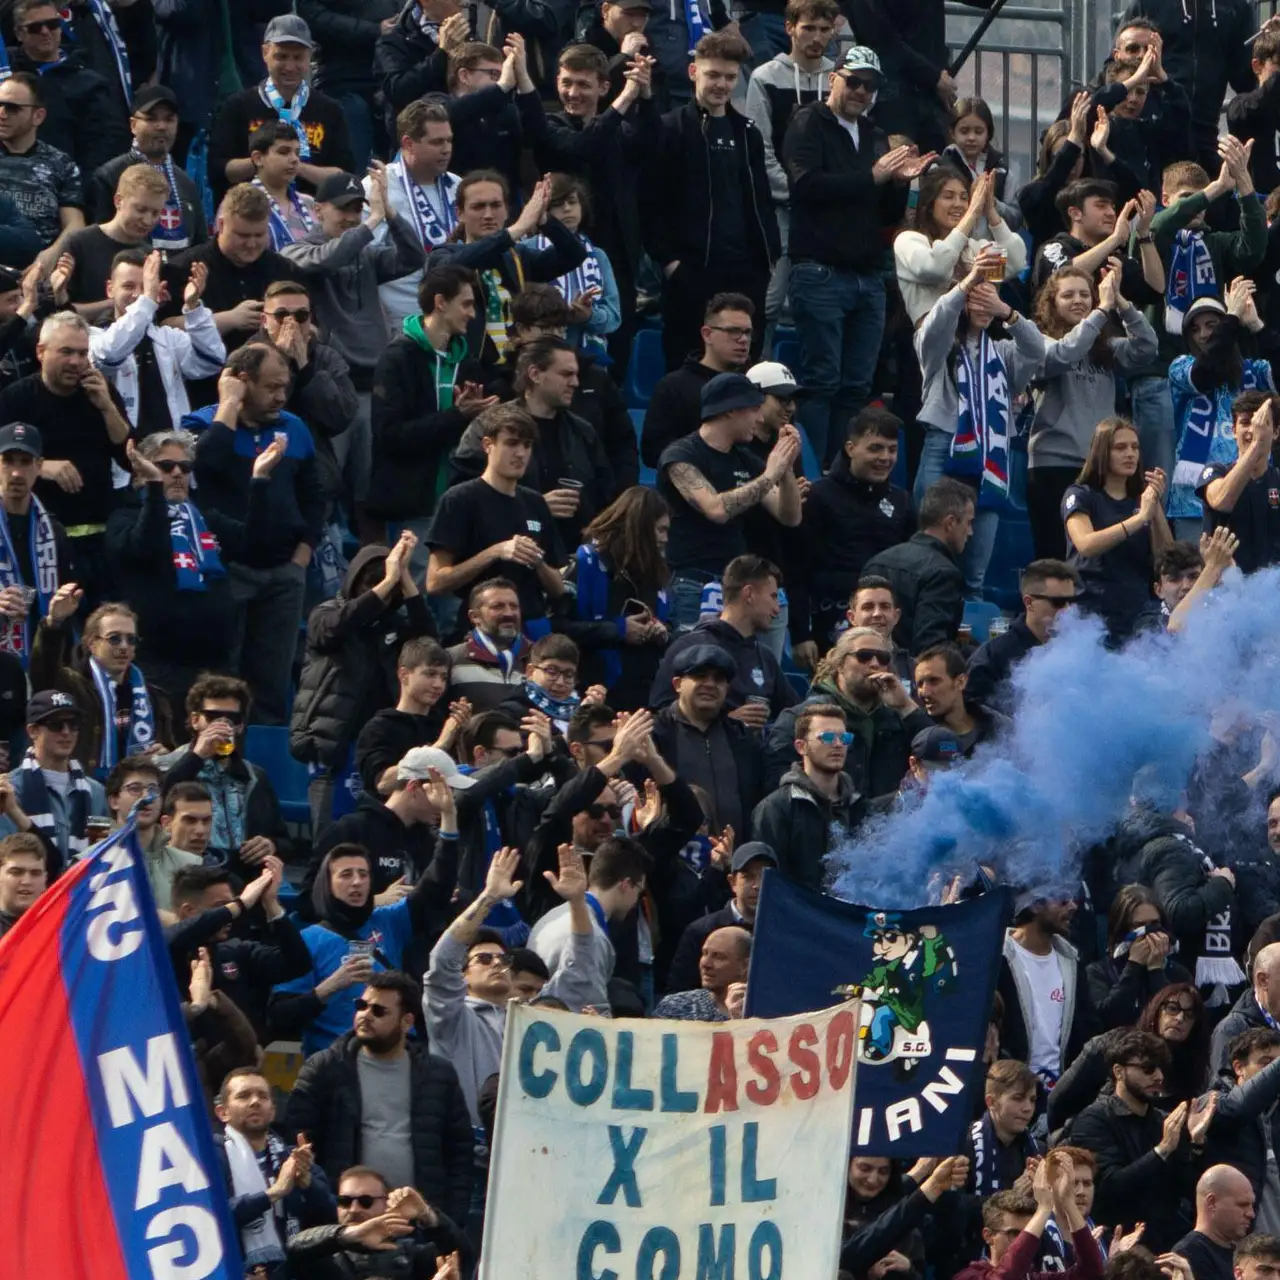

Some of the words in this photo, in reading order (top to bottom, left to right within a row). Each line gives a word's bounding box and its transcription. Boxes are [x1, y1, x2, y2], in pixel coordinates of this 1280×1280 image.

[518, 1010, 855, 1114] COLLASSO
[596, 1125, 648, 1208] X
[709, 1121, 778, 1207] IL
